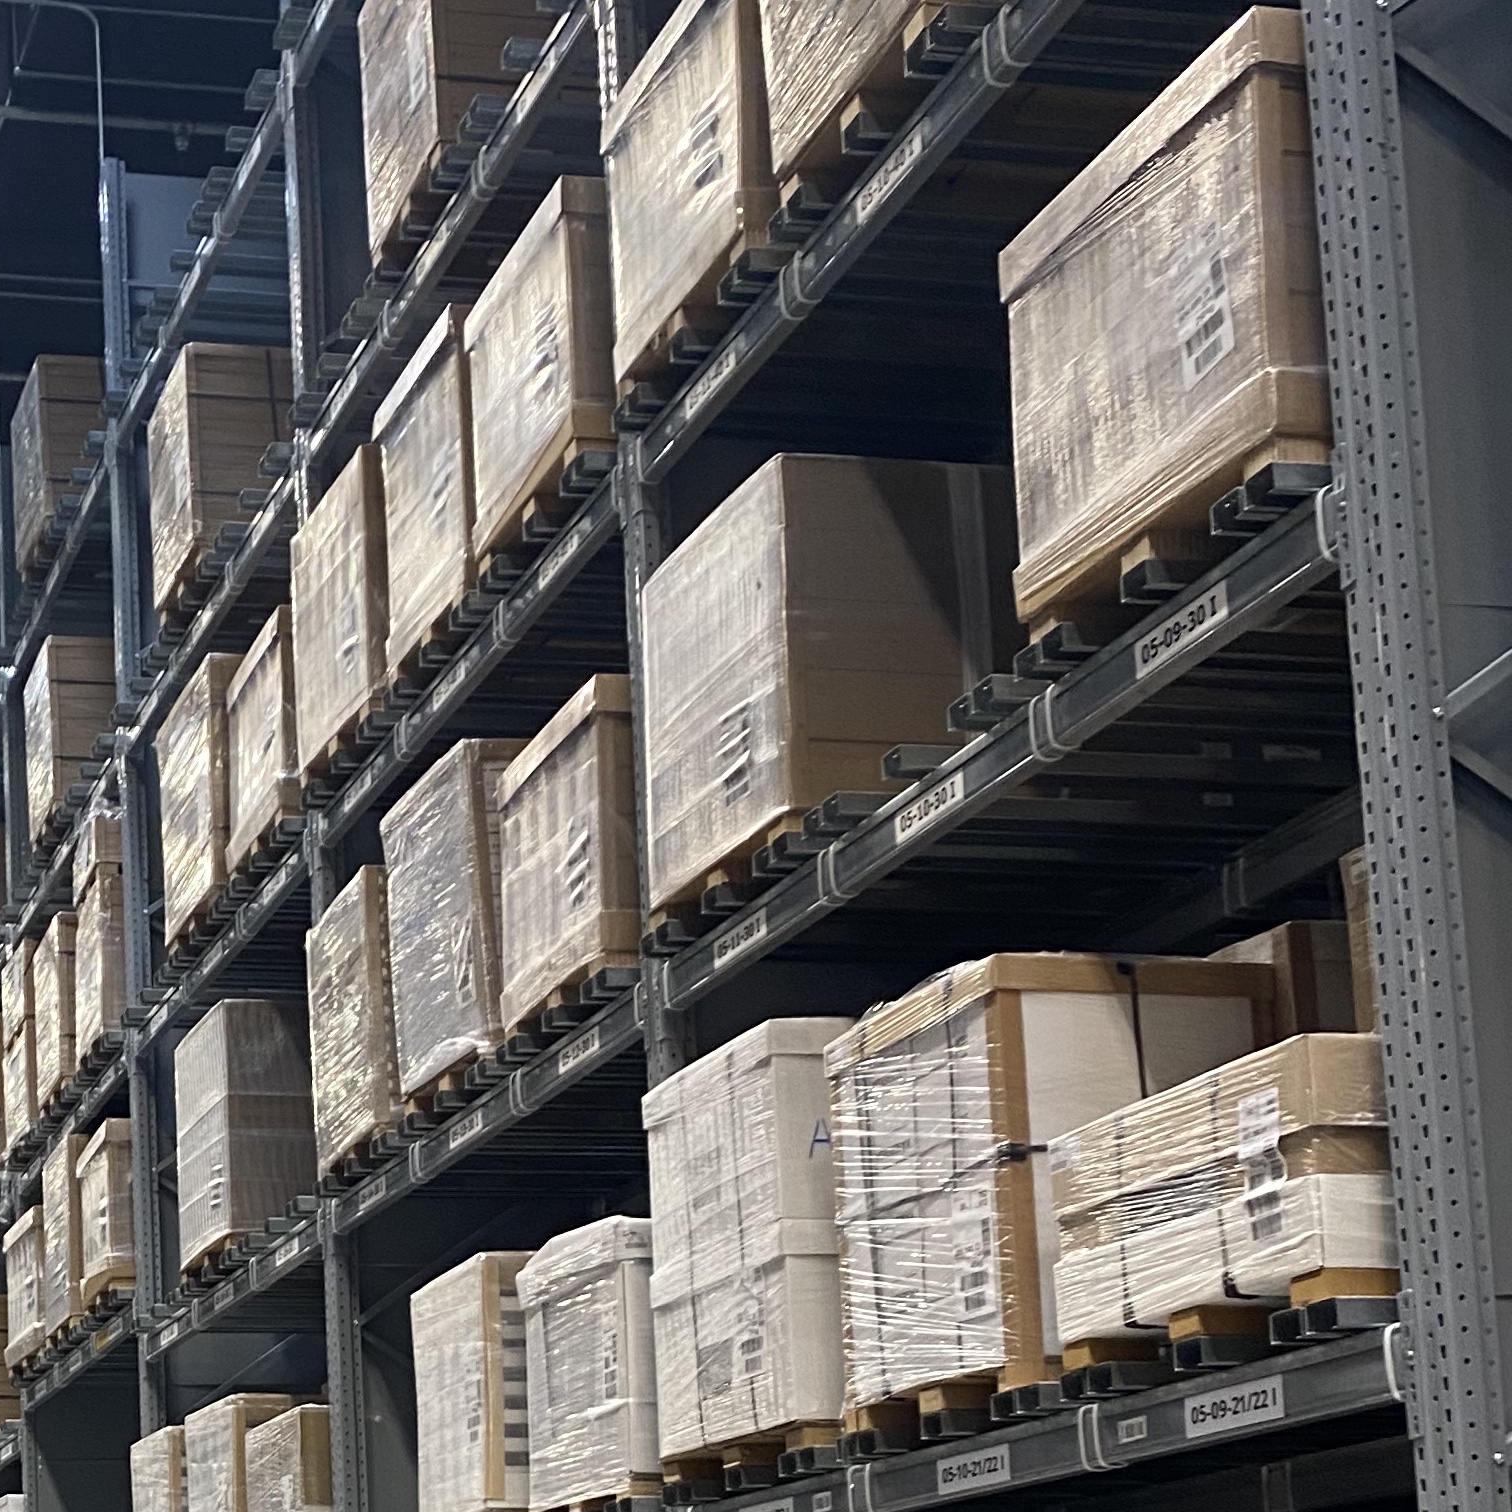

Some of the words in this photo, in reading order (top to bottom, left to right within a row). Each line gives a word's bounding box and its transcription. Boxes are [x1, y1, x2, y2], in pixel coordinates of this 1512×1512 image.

[1141, 603, 1206, 664] 05-09-30
[899, 787, 947, 832] 05-10-30
[717, 924, 755, 959] 05-11-30
[808, 1116, 831, 1159] A
[1190, 1389, 1269, 1424] 05-09-21/22
[941, 1456, 999, 1483] 05-10-21/22
